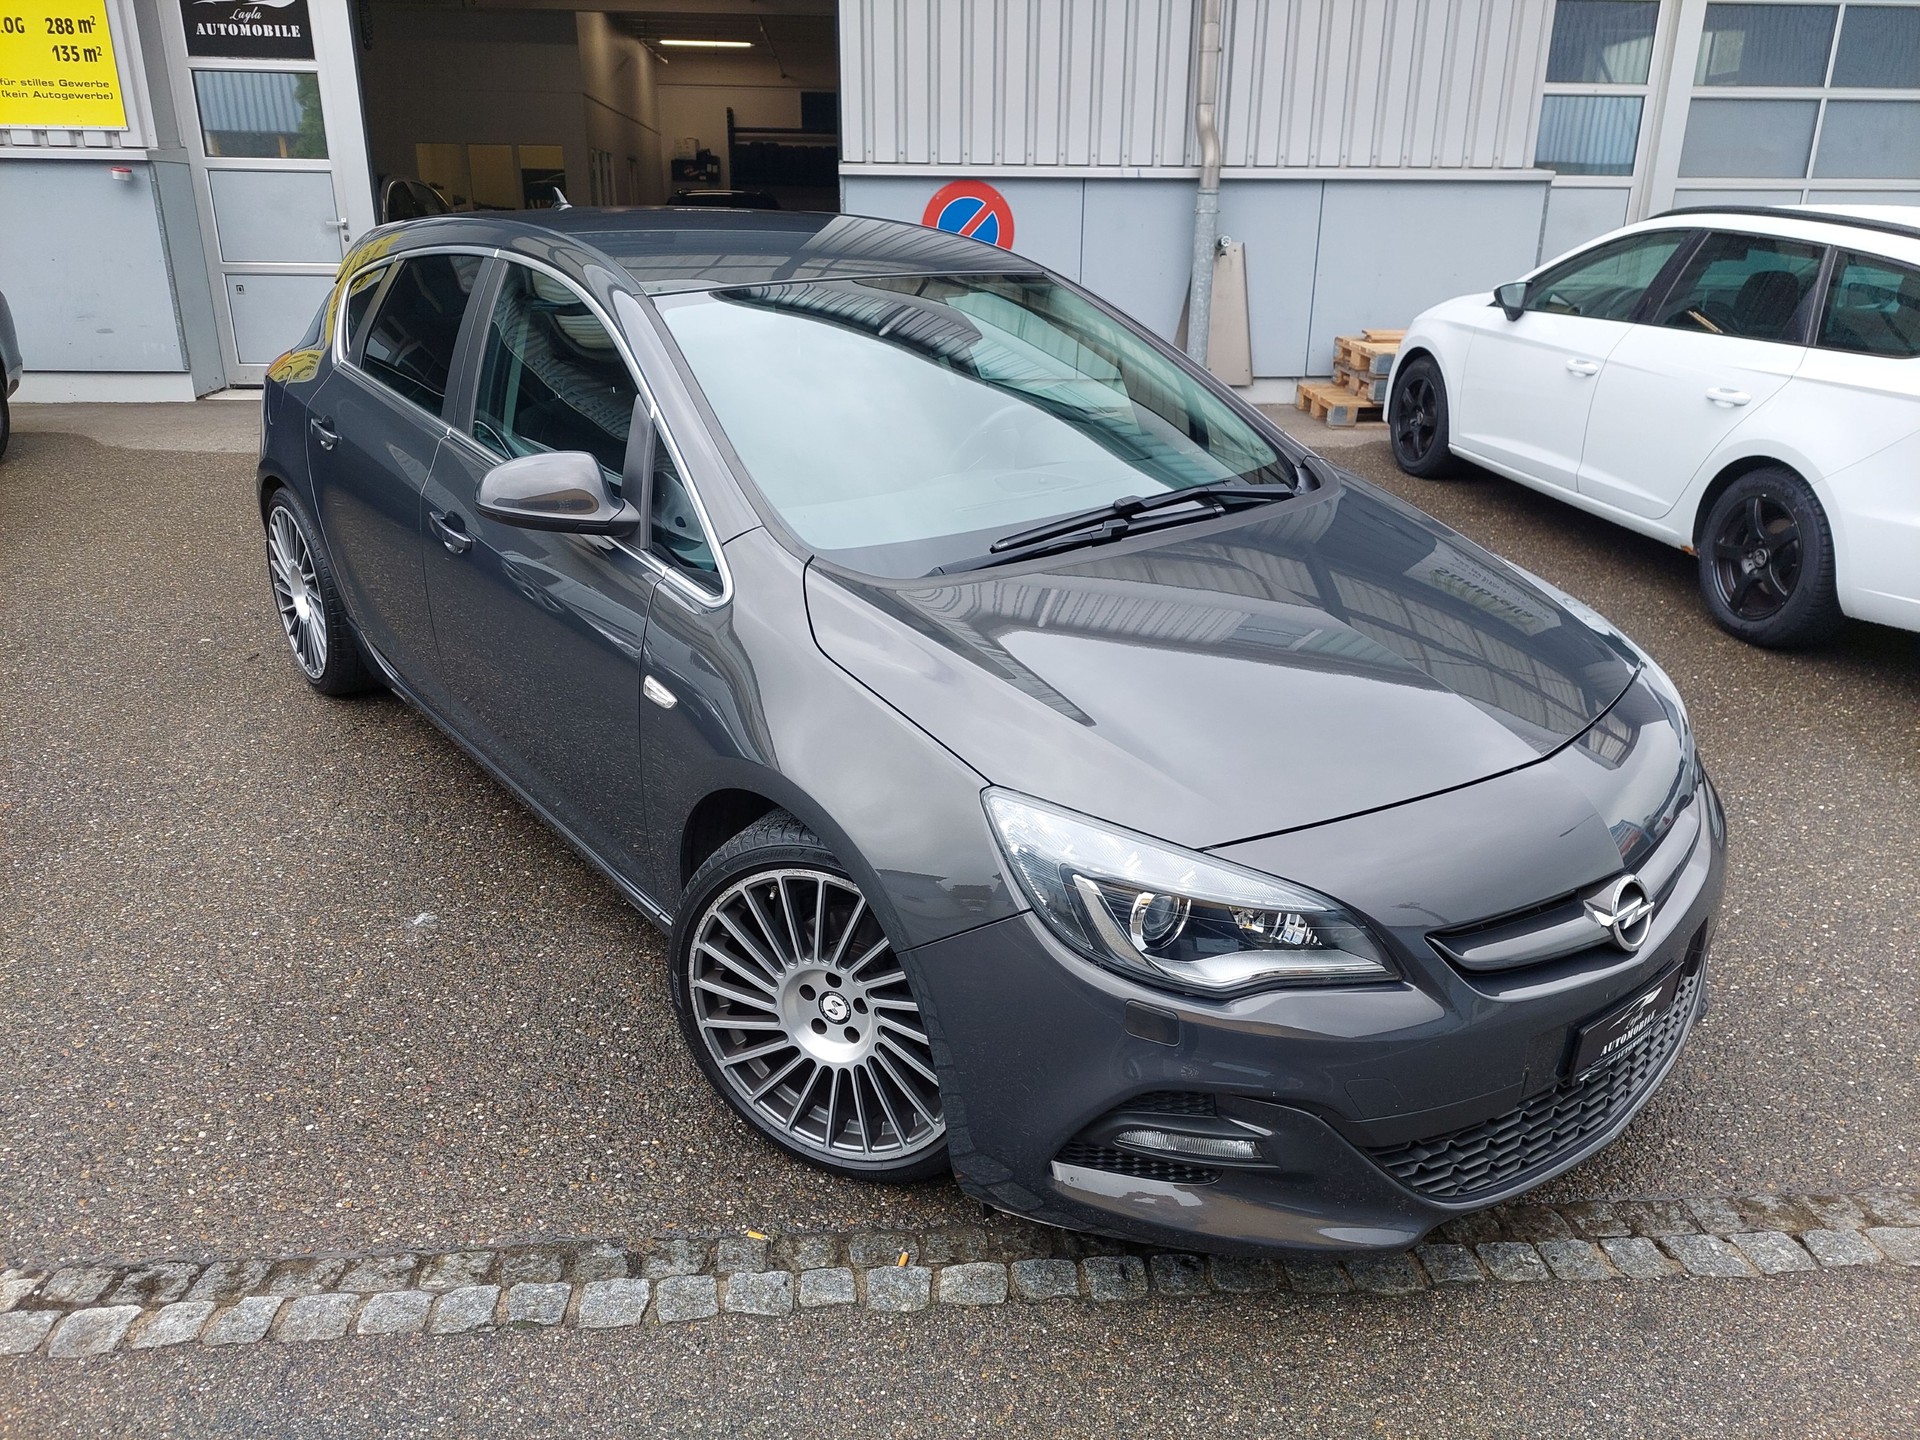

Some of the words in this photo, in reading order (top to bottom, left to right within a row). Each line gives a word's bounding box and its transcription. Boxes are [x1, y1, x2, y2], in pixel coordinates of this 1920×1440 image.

[229, 6, 262, 23] Layla
[45, 17, 75, 35] 288
[196, 22, 301, 38] AUTOMOBILE
[52, 45, 80, 62] 135
[0, 77, 16, 87] für
[20, 78, 55, 87] stilles
[58, 79, 110, 88] Gewerbe
[1, 89, 28, 98] (kein
[33, 90, 114, 100] Autogewerbe)
[1600, 1008, 1657, 1057] AUTOMOBILE
